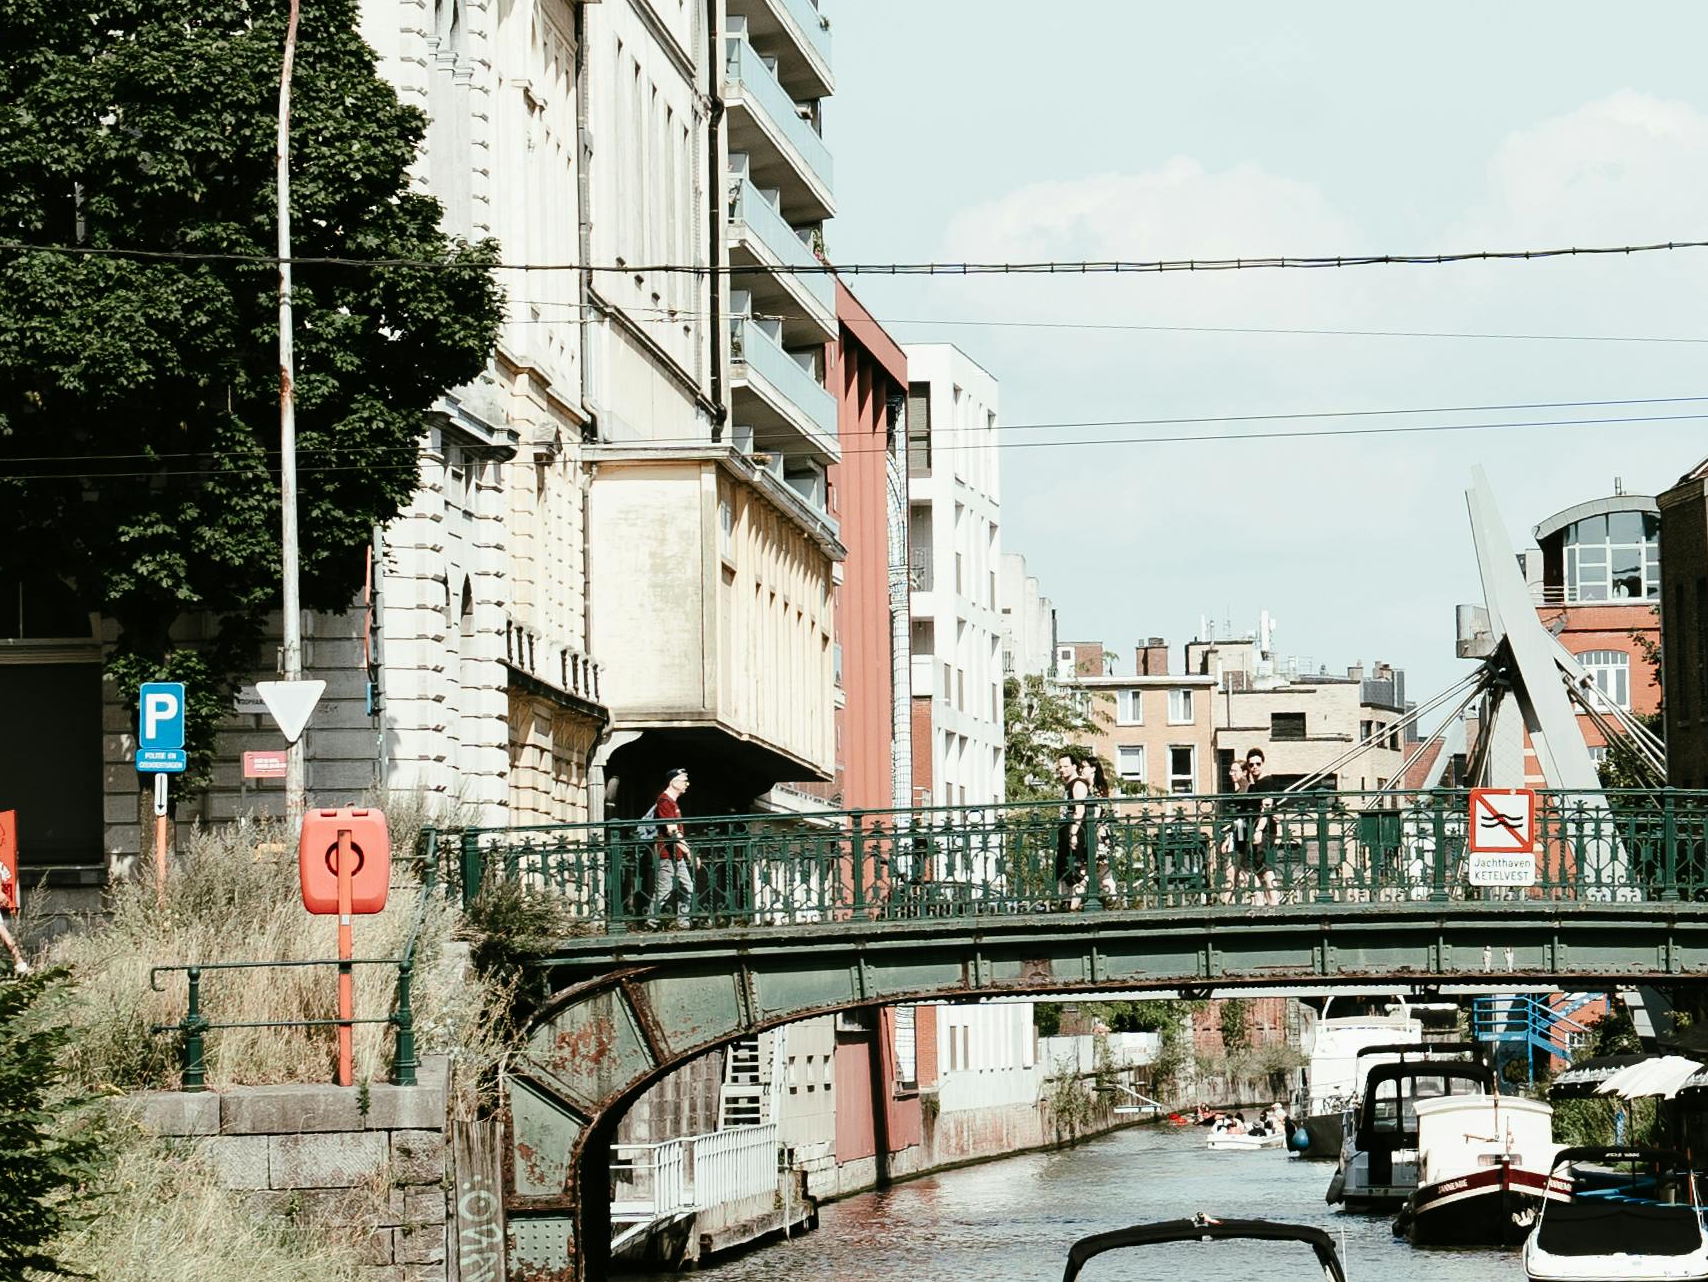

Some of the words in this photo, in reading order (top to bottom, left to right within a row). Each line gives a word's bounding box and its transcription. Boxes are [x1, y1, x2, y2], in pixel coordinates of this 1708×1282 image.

[145, 693, 178, 740] P
[1474, 858, 1531, 868] Jachthaven
[1474, 871, 1529, 881] KETELVEST
